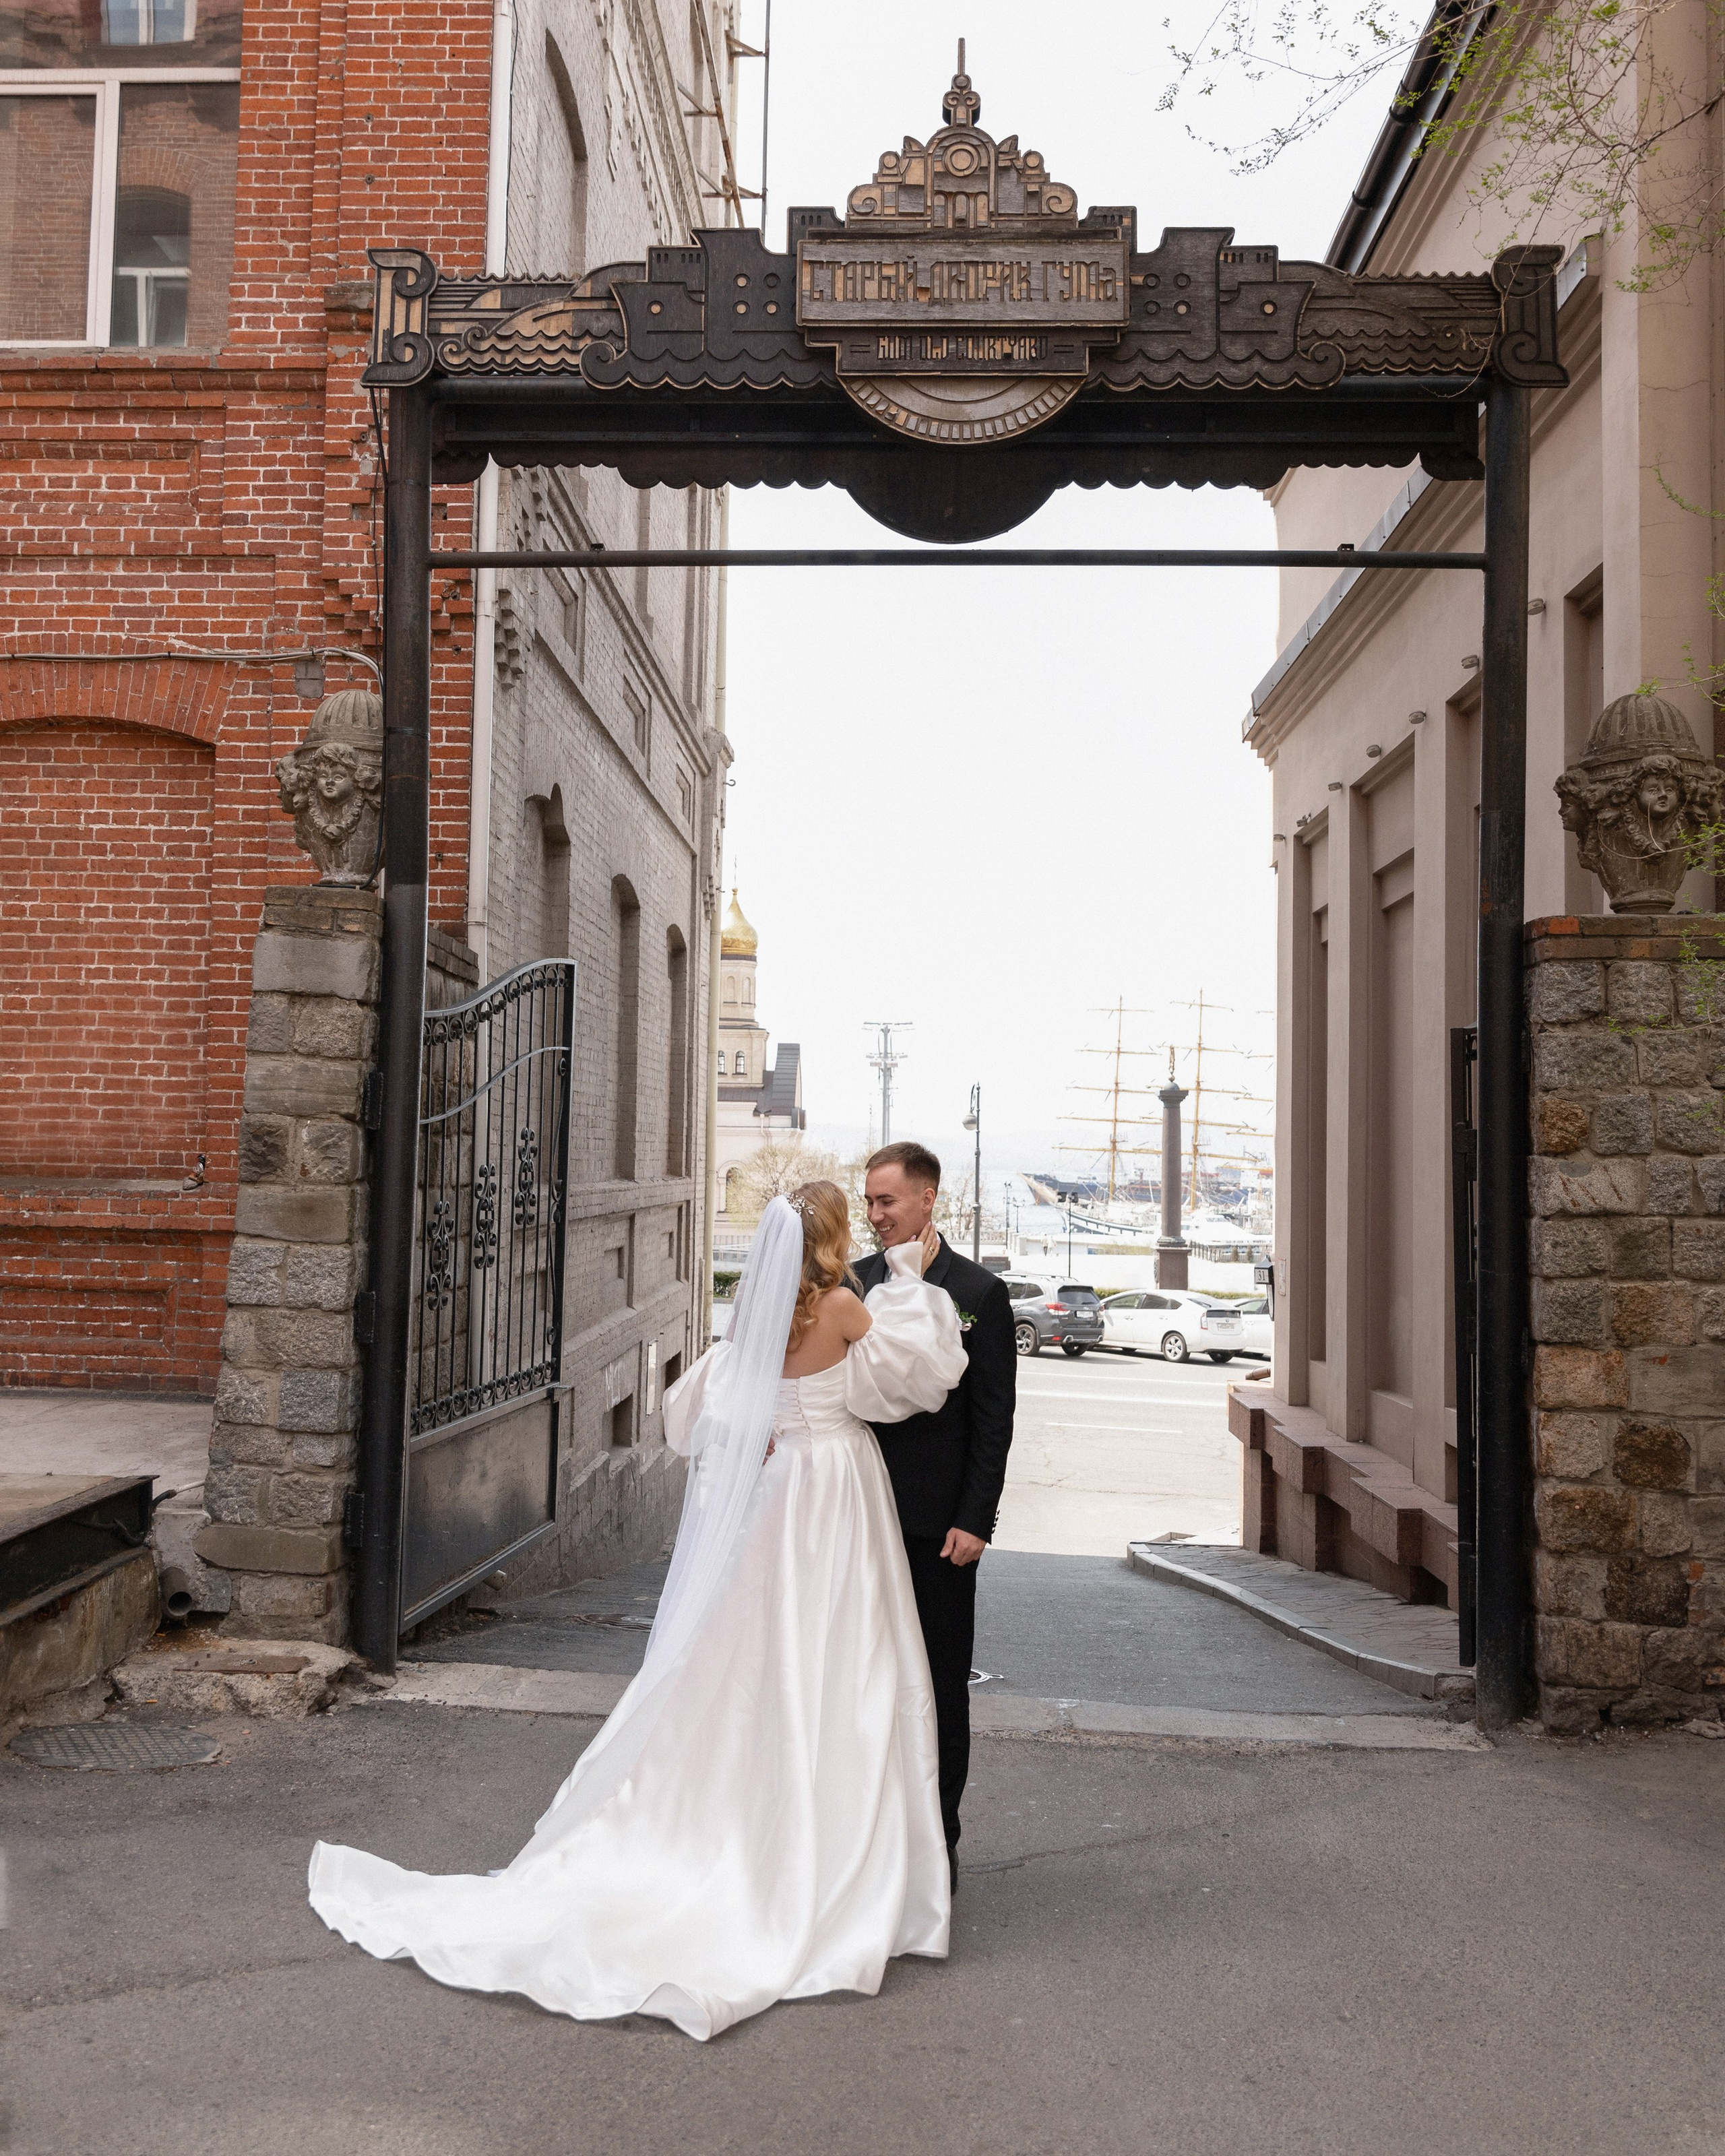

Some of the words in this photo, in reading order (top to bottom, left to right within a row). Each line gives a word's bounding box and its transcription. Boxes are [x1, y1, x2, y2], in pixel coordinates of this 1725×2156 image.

[809, 255, 918, 303] СТАРЫЙ
[928, 261, 1032, 307] ДВОРИК
[877, 336, 913, 360] GUM
[919, 336, 949, 360] OLD
[955, 336, 1048, 360] COURTYARD
[1258, 1270, 1266, 1281] 31
